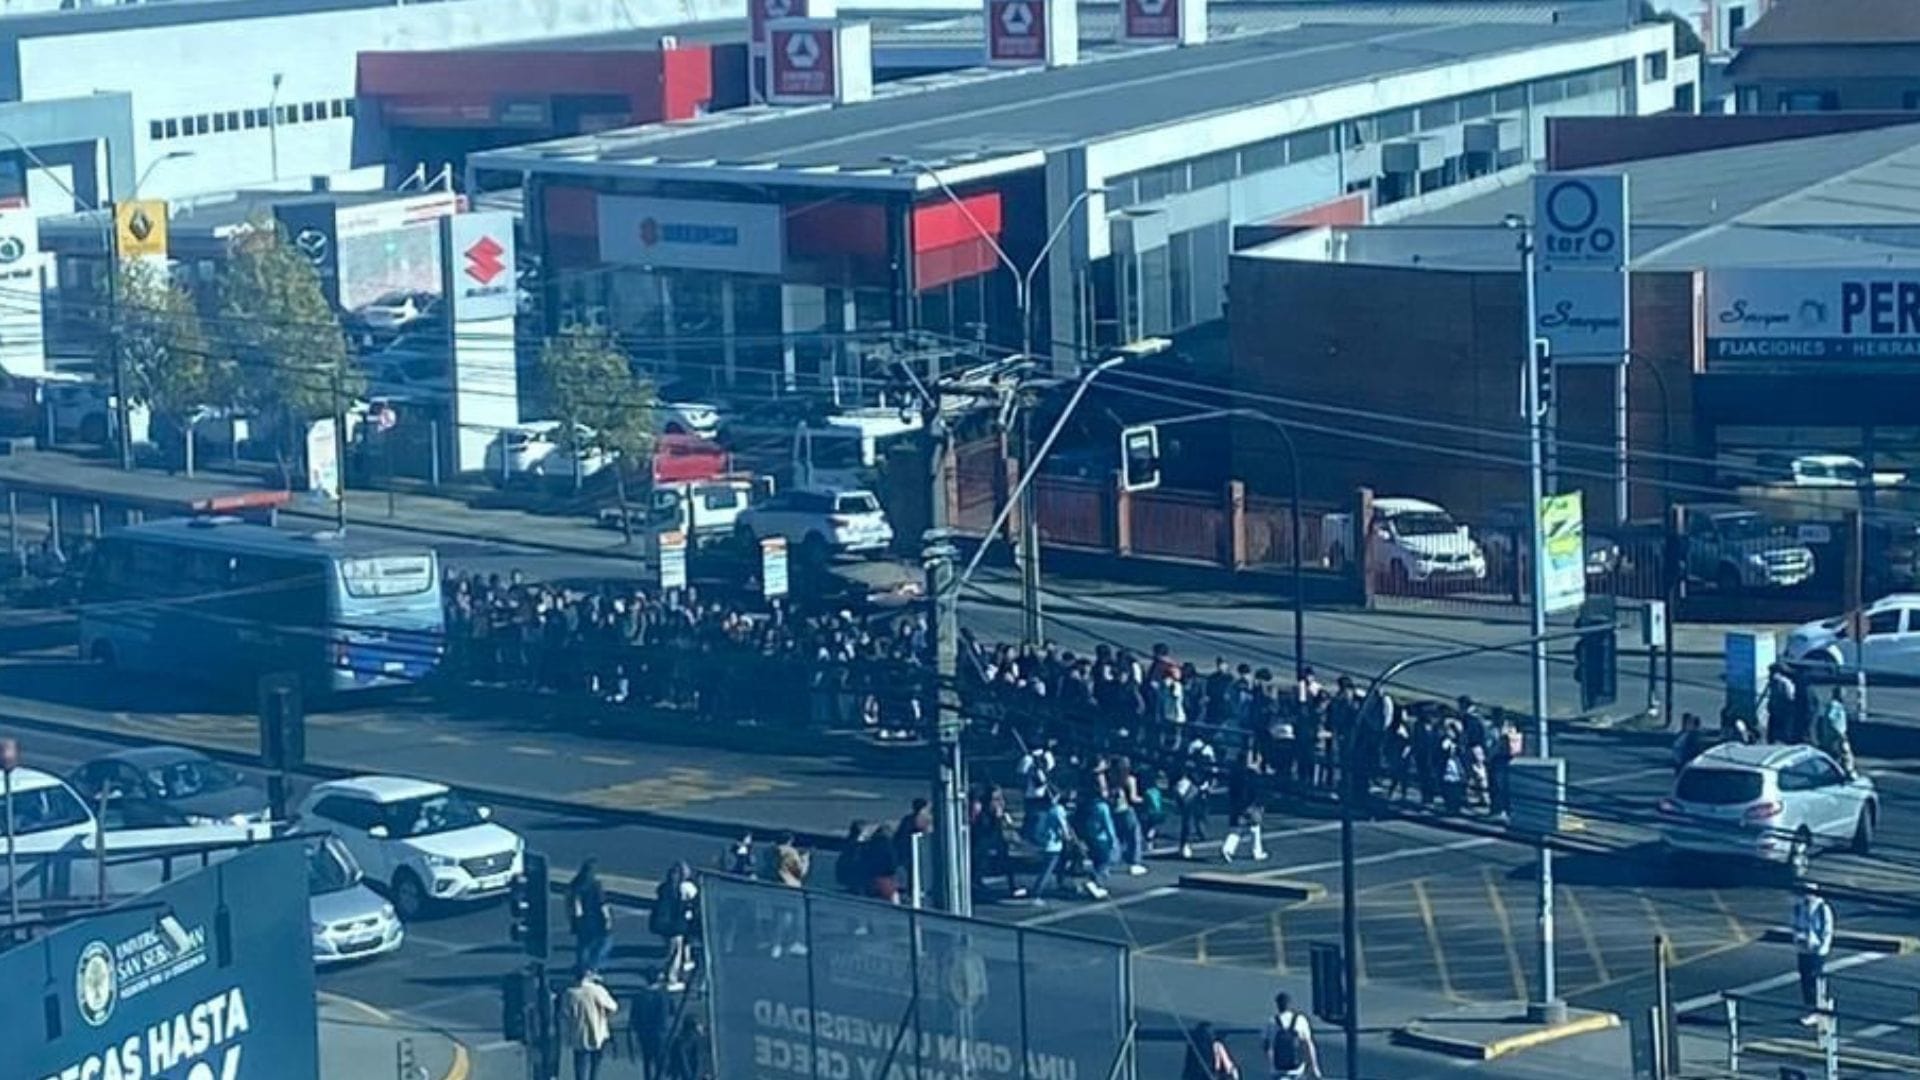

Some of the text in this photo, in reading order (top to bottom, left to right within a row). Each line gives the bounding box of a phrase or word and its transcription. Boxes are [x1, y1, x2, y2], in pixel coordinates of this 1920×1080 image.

[1841, 281, 1920, 335] PER
[1853, 340, 1920, 357] HERRA
[148, 986, 249, 1076] HASTA
